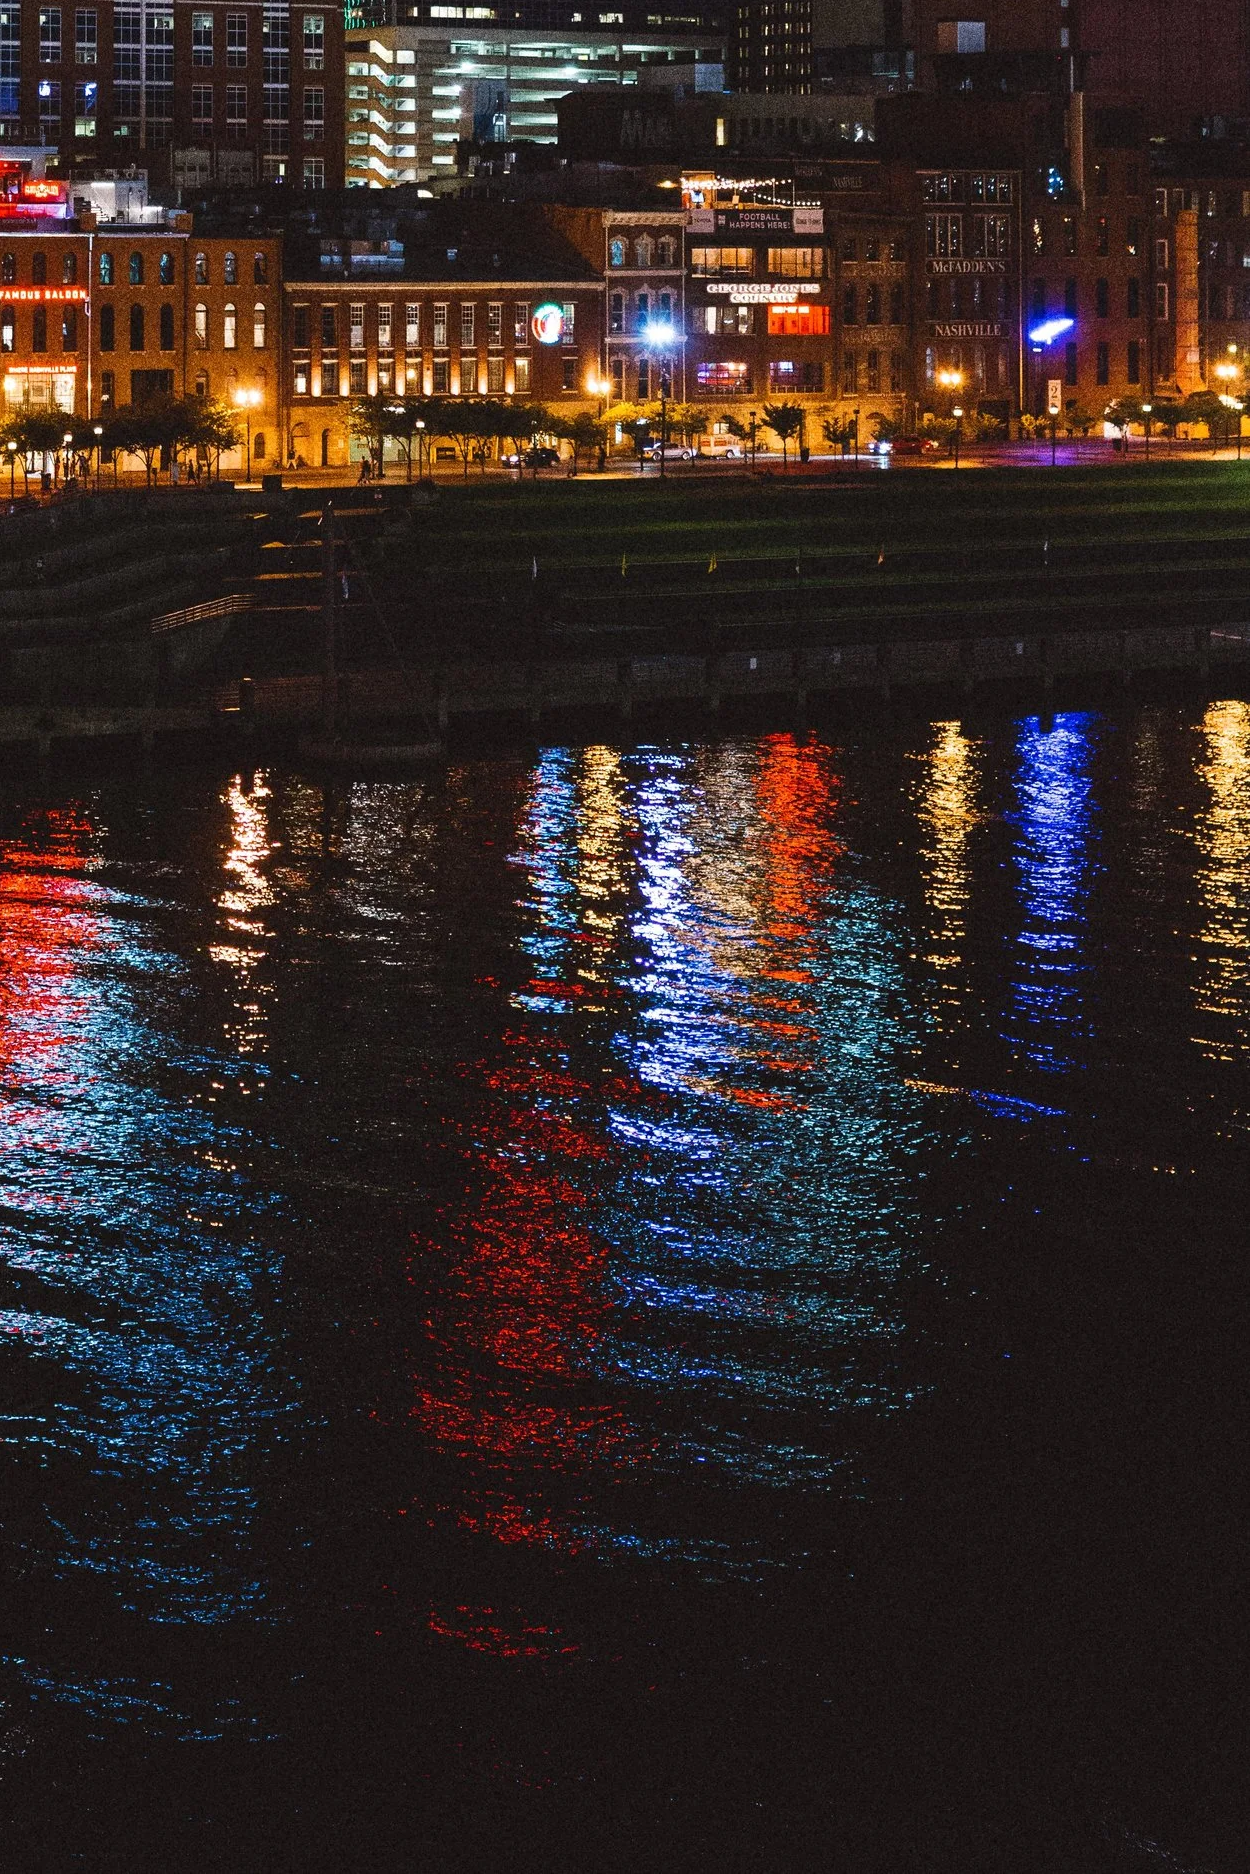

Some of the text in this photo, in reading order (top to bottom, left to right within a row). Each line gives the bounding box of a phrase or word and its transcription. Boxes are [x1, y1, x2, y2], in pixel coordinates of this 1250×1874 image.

[739, 212, 781, 222] FOOTBALL
[730, 221, 765, 230] HAPPENS
[932, 260, 1006, 274] McFADDEN'S
[44, 289, 87, 299] SALOON
[706, 283, 821, 294] GEORGE JONES
[730, 293, 798, 304] COUNTRY
[935, 324, 1001, 337] NASHVILLE
[1050, 386, 1058, 398] 2
